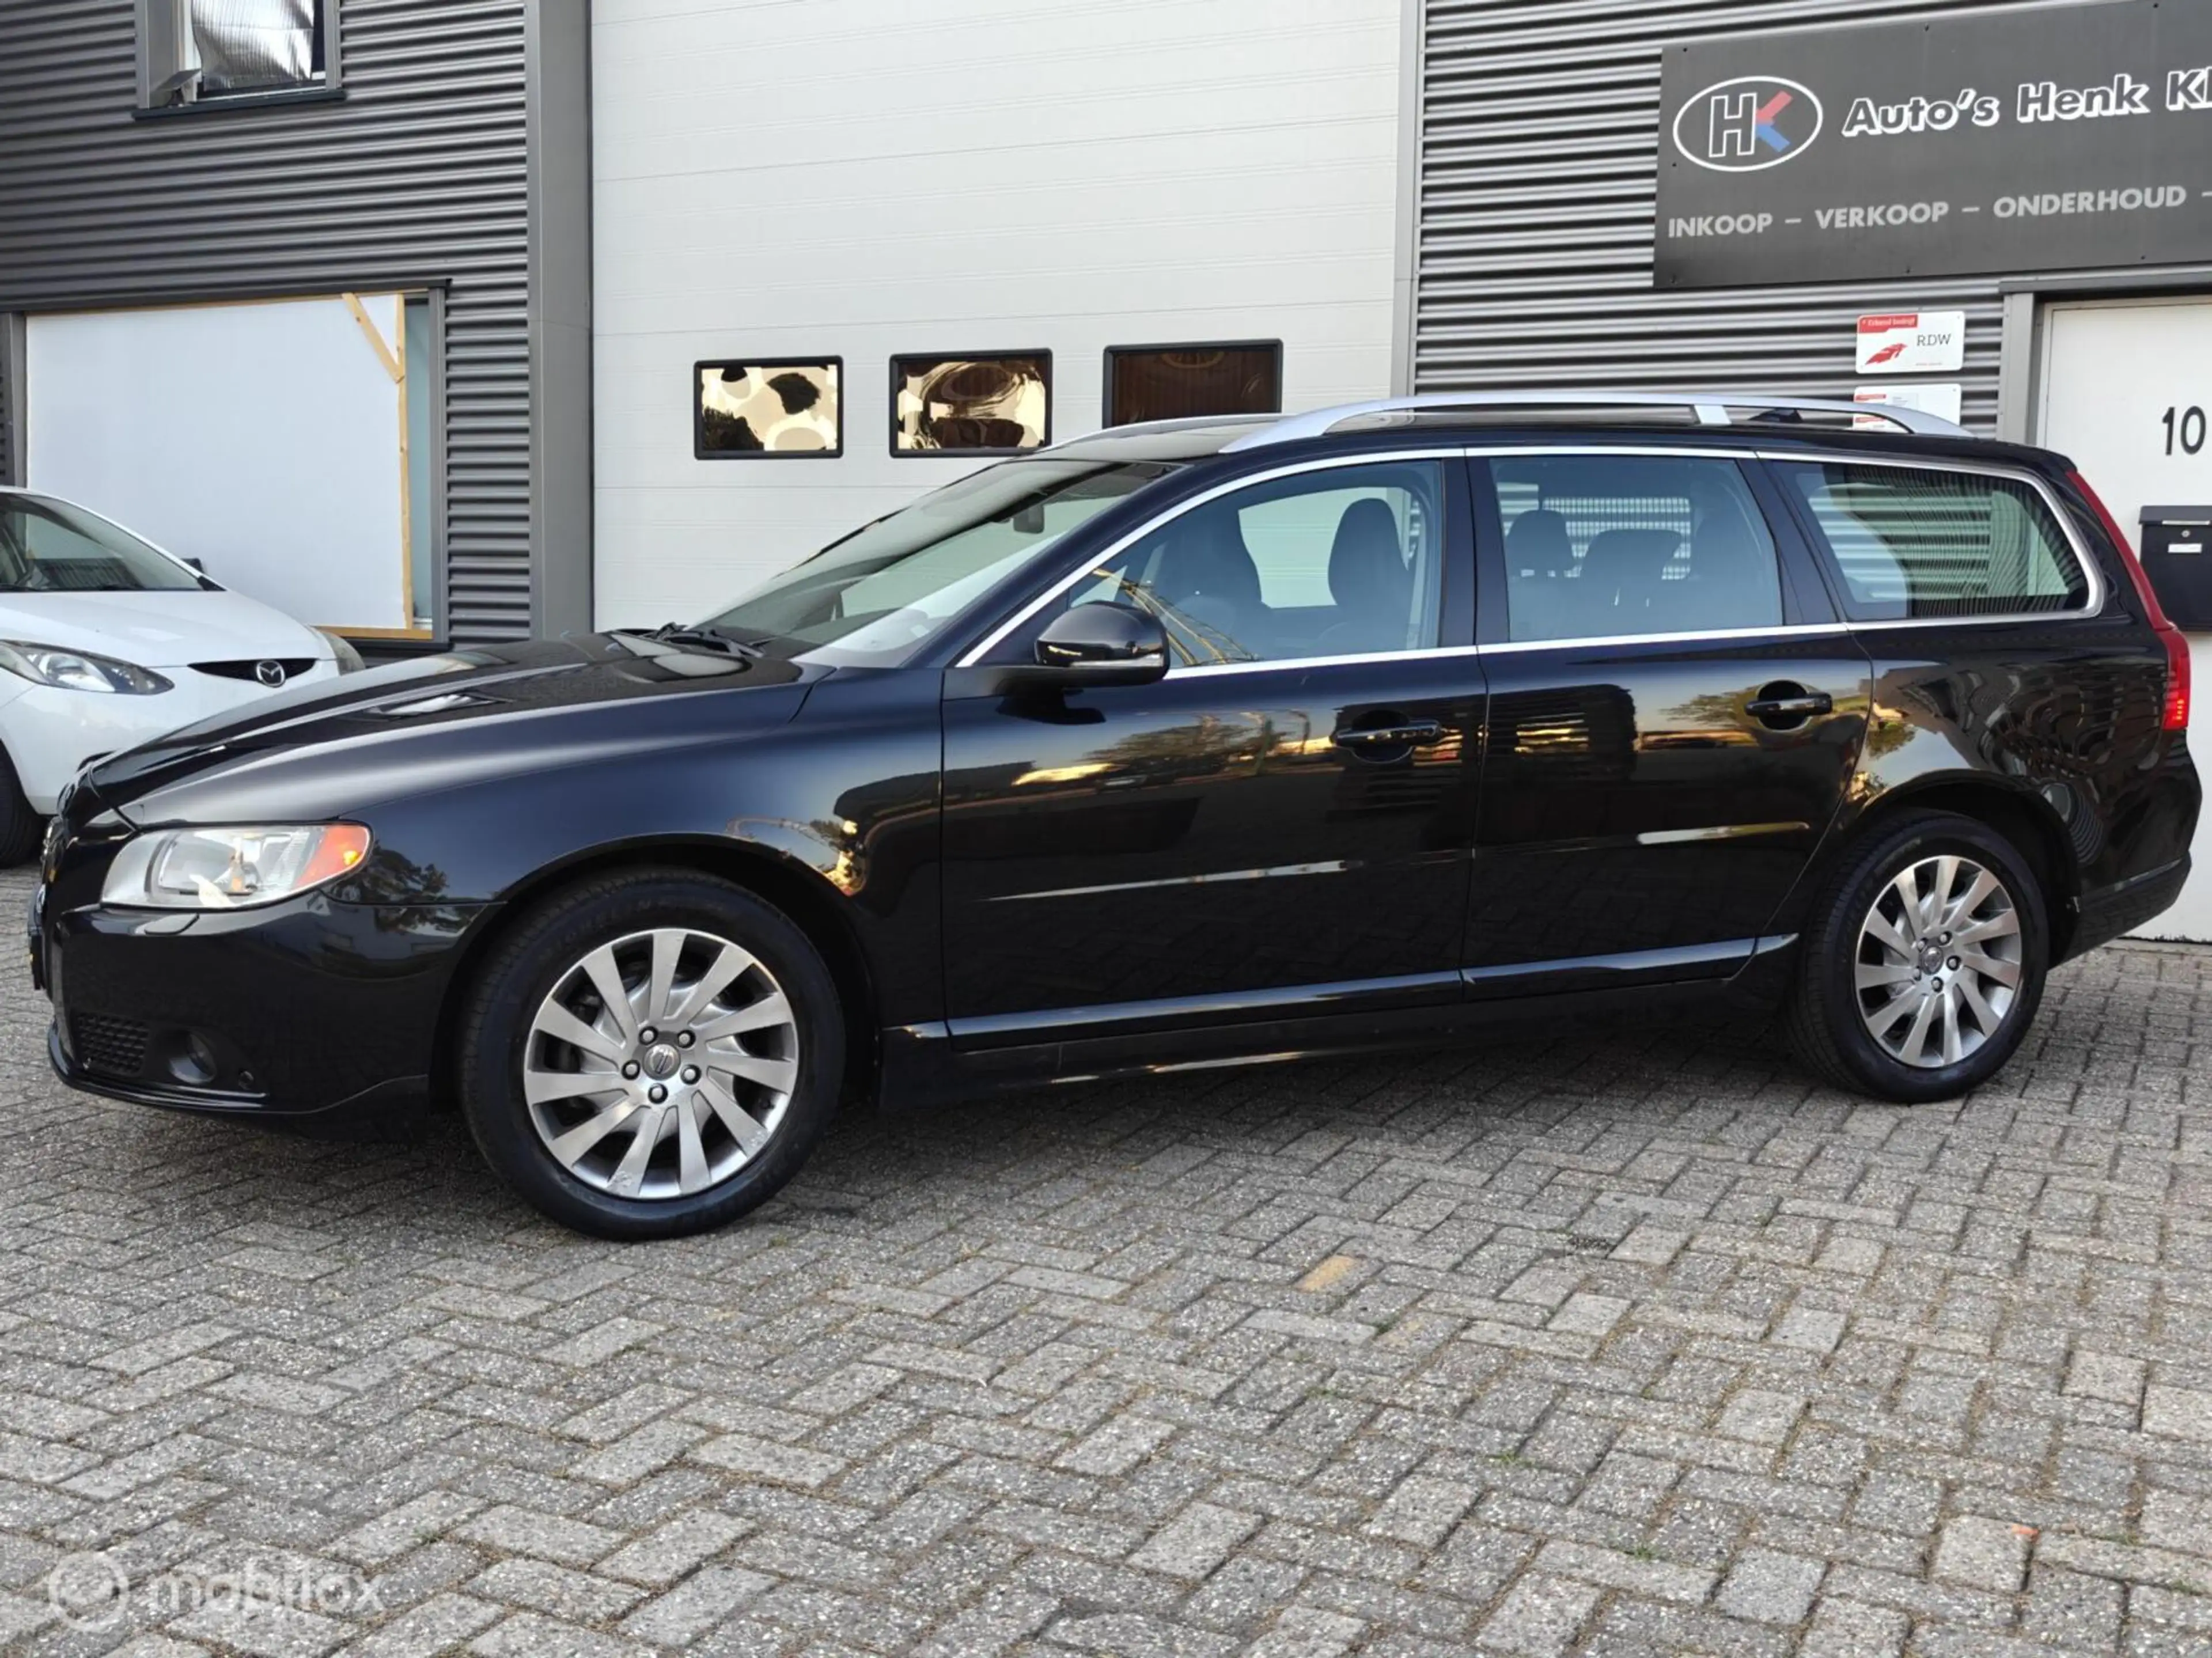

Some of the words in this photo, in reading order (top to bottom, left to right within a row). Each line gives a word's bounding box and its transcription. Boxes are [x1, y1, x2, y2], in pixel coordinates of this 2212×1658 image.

[1841, 88, 2001, 137] Auto's
[2016, 73, 2152, 123] Henk
[1668, 212, 1773, 238] INKOOP
[1814, 201, 1949, 229] VERKOOP
[1993, 185, 2187, 218] ONDERHOUD
[1916, 333, 1952, 347] RDW
[2162, 405, 2207, 456] 10
